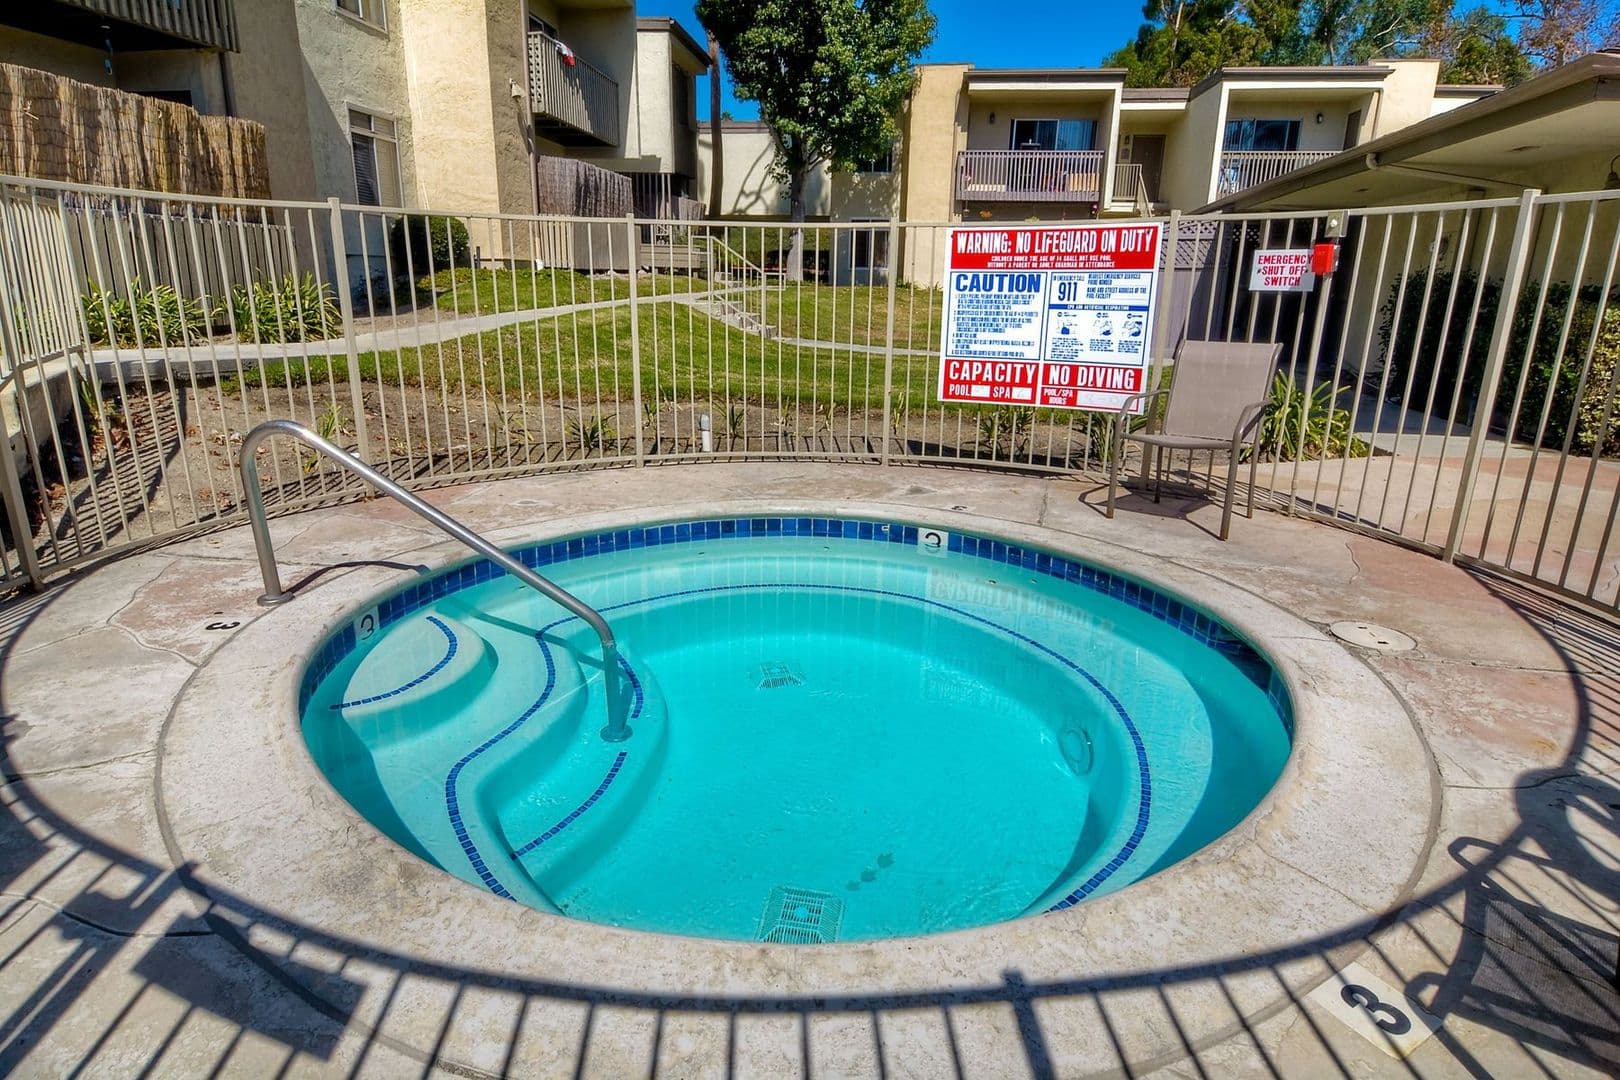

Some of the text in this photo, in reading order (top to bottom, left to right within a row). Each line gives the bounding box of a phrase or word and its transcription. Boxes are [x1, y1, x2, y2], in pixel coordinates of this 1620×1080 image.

[957, 228, 1153, 254] WARNING: NO LIFEGUARD ON DUTY
[1258, 254, 1314, 265] EMERGENCY
[1262, 266, 1306, 275] SHUT OFF
[955, 274, 1041, 292] CAUTION
[1264, 277, 1301, 286] SWITCH
[1058, 282, 1077, 301] 911
[949, 361, 1036, 384] CAPACITY
[1048, 365, 1135, 390] NO DIVING
[949, 384, 970, 396] POOL
[992, 386, 1011, 399] SPA
[1043, 388, 1073, 398] POOL/SPA
[1340, 984, 1412, 1035] 3
